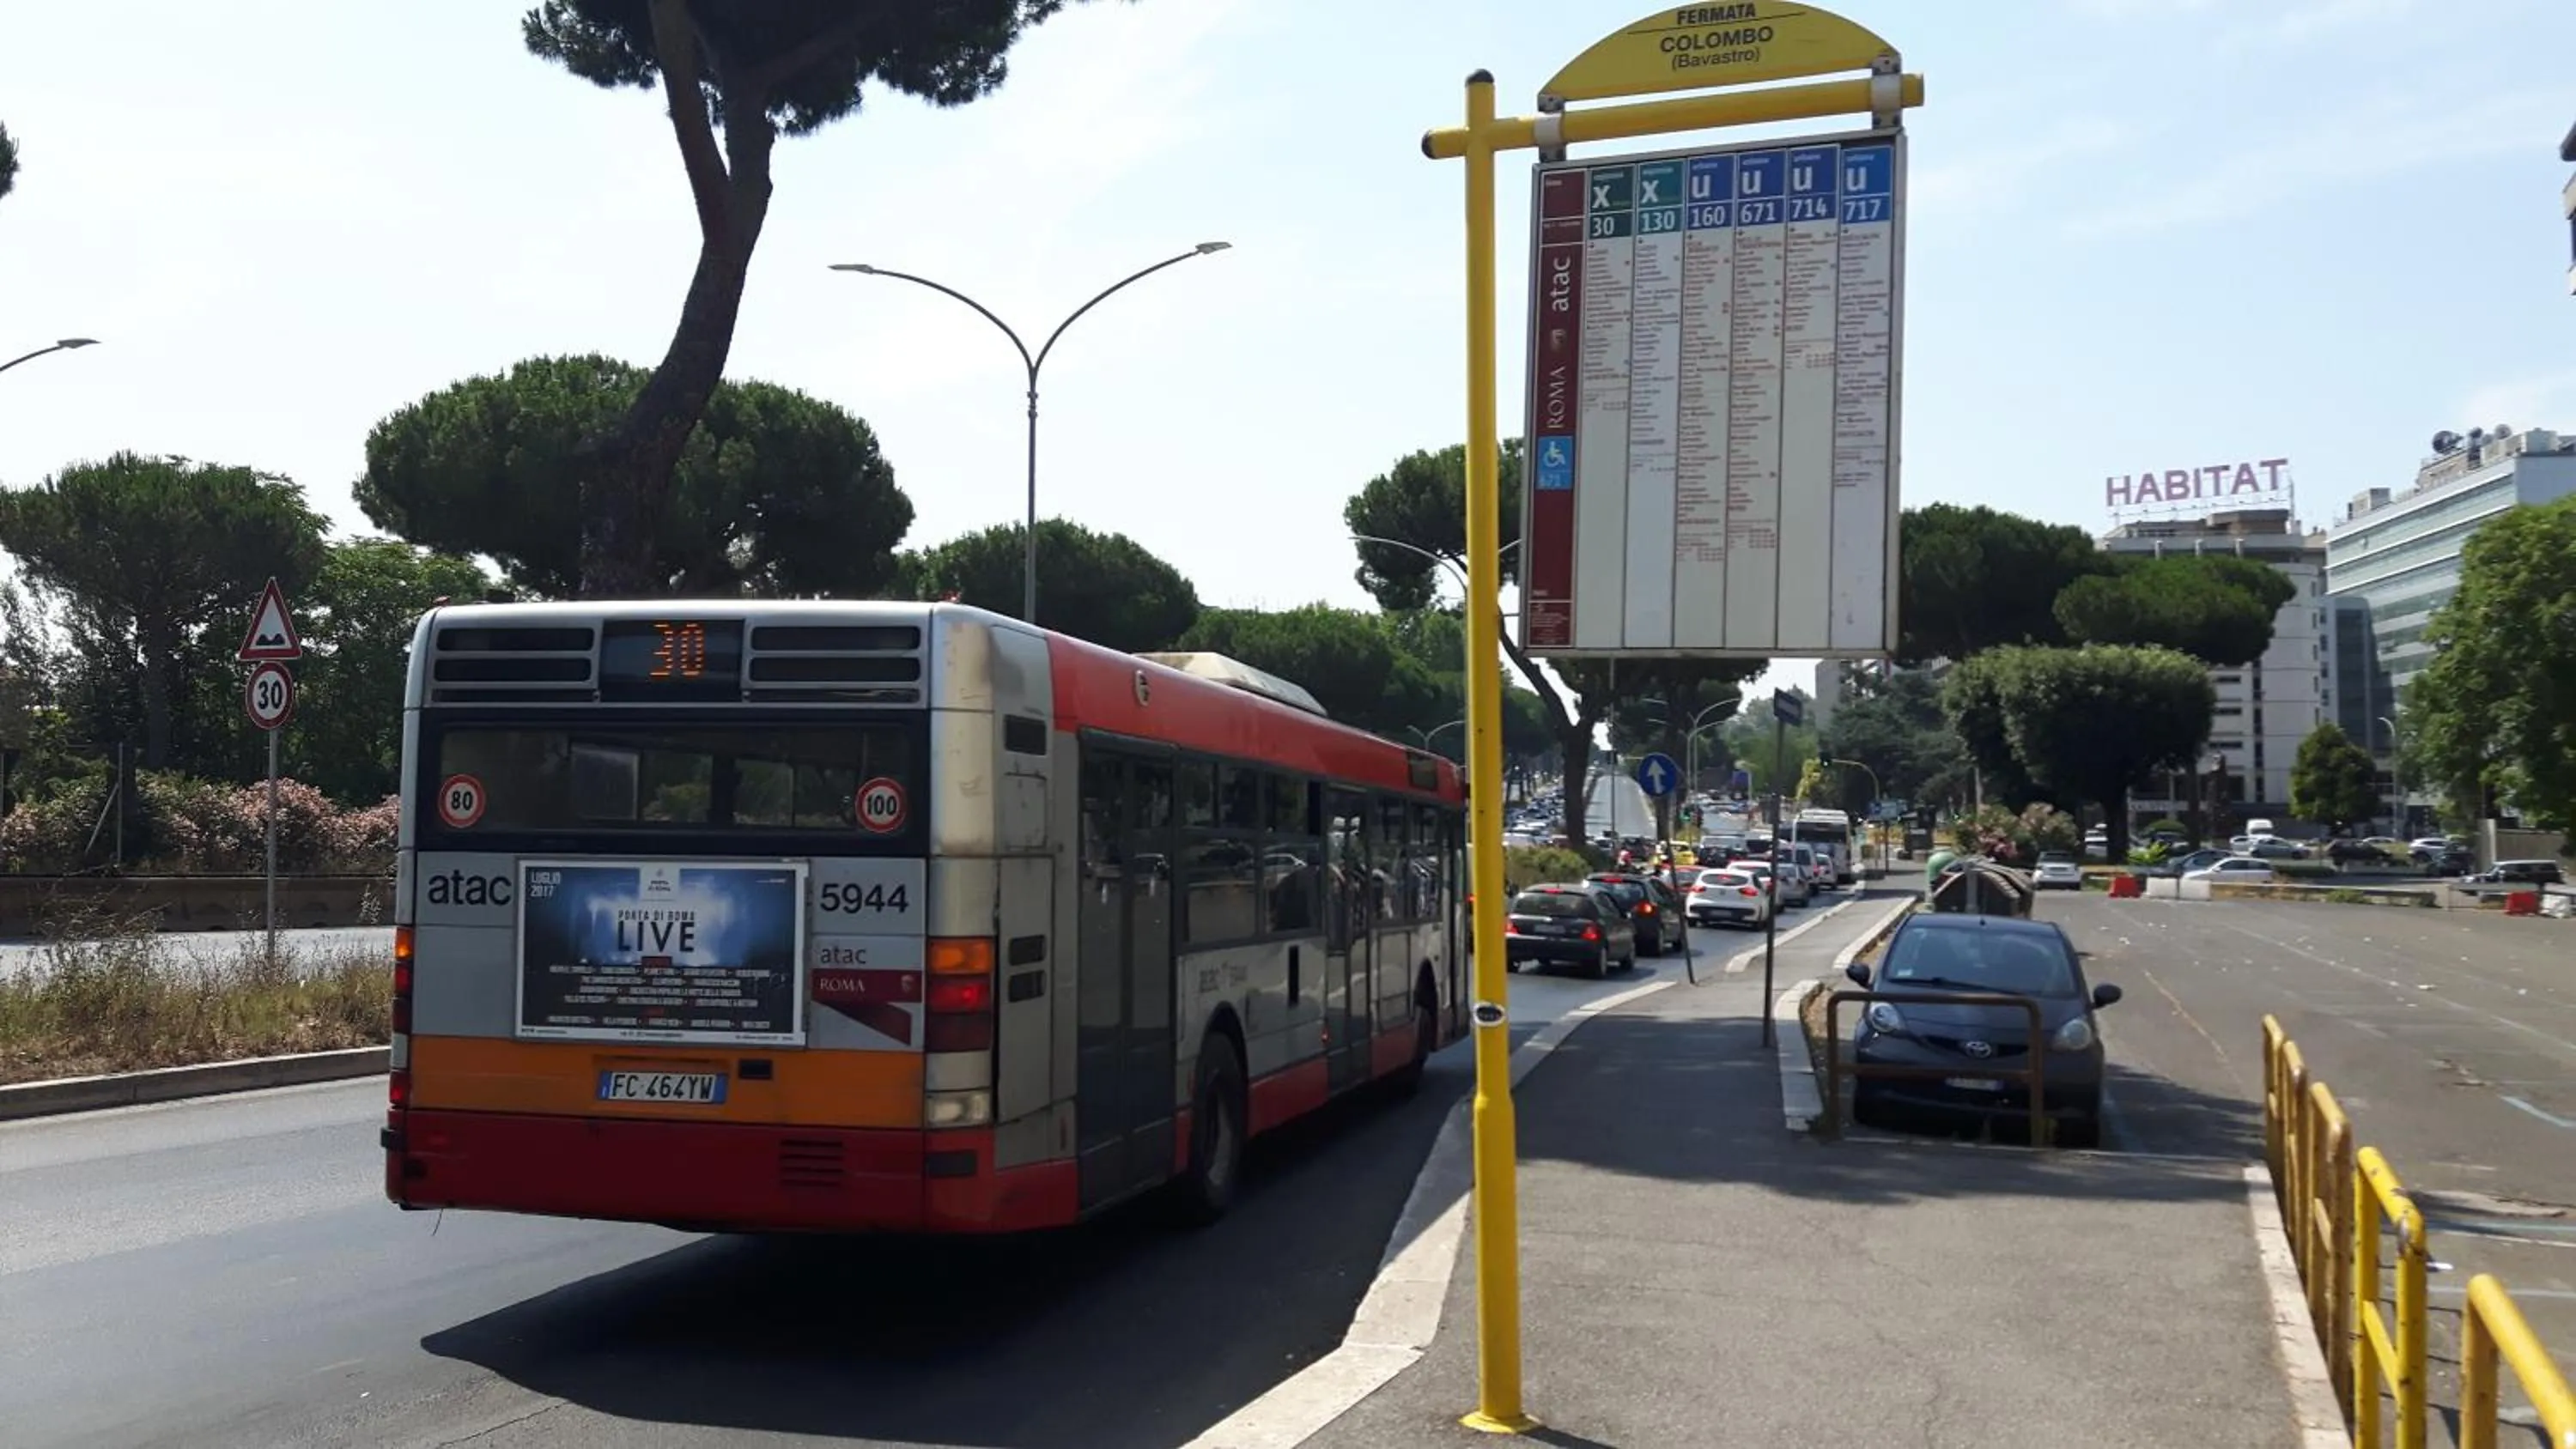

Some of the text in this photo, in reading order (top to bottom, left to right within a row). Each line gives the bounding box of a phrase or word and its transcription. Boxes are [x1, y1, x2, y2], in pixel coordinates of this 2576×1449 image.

[1677, 3, 1756, 24] FERMATA
[1661, 26, 1773, 52] COLOMBO
[1672, 46, 1760, 70] (Bavastro)
[1692, 205, 1725, 227] 160
[1740, 202, 1776, 222] 671
[1791, 197, 1827, 219] 714
[1846, 199, 1881, 221] 717
[1592, 216, 1615, 236] 30
[1641, 210, 1675, 232] 130
[1550, 256, 1571, 312] atac
[1546, 366, 1566, 427] ROMA
[2106, 458, 2288, 506] HABITAT
[650, 623, 702, 676] 30
[258, 681, 283, 710] 30
[451, 791, 473, 811] 80
[866, 794, 897, 816] 100
[428, 870, 512, 905] atac
[530, 885, 554, 898] 2017
[820, 882, 909, 913] 5944
[617, 921, 695, 953] LIVE
[820, 946, 866, 964] atac
[820, 978, 866, 992] ROMA
